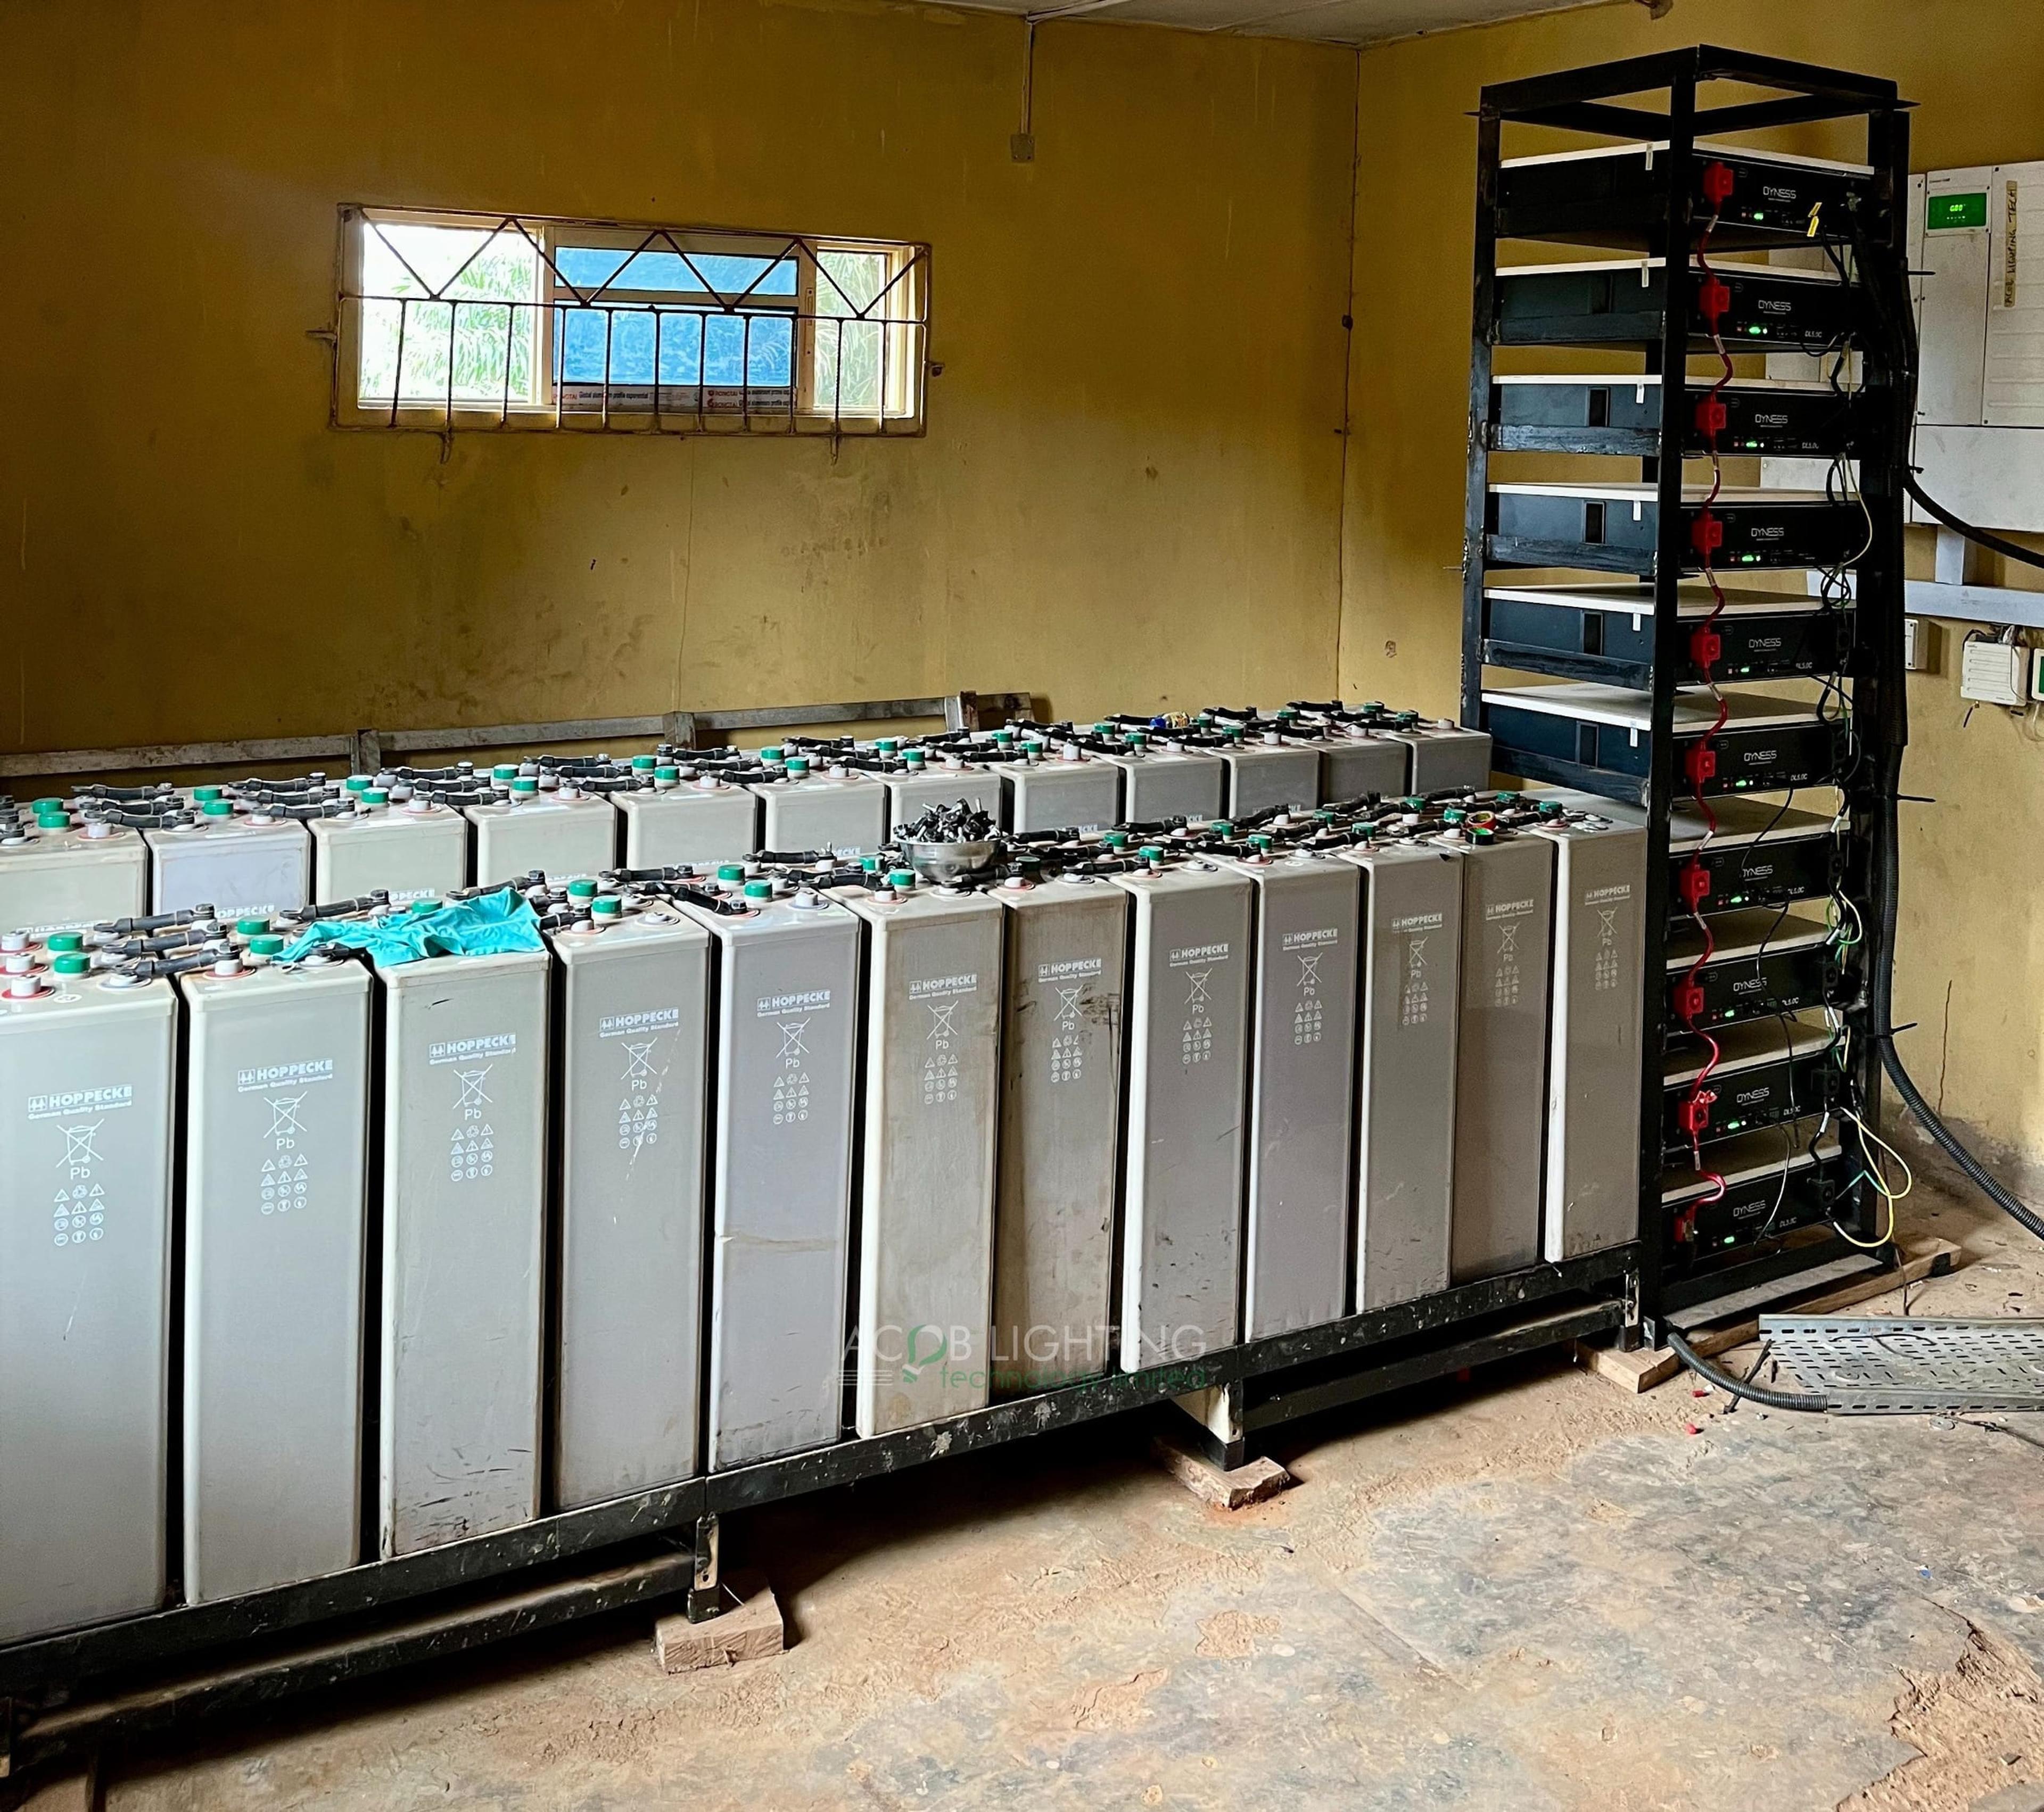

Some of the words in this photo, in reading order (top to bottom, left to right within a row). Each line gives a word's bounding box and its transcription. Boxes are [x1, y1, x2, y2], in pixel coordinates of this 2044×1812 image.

[1763, 186, 1796, 199] DYNESS
[1758, 300, 1791, 311] DYNESS
[1755, 414, 1788, 424] DYNESS
[1751, 527, 1784, 537] DYNESS
[1749, 638, 1782, 648] DYNESS
[1744, 750, 1777, 762] DYNESS
[1293, 928, 1338, 942] HOPPECKE
[1181, 944, 1229, 958] HOPPECKE
[1051, 958, 1102, 974] HOPPECKE
[922, 974, 977, 990] HOPPECKE
[772, 990, 830, 1008] HOPPECKE
[1192, 1004, 1204, 1015] Pb
[615, 1008, 679, 1027] HOPPECKE
[1062, 1021, 1075, 1031] Pb
[447, 1034, 516, 1054] HOPPECKE
[936, 1039, 949, 1050] Pb
[257, 1059, 333, 1081] HOPPECKE
[786, 1057, 800, 1069] Pb
[631, 1079, 647, 1091] Pb
[49, 1086, 133, 1107] HOPPECKE
[1736, 1087, 1770, 1104] DYNESS
[28, 1111, 62, 1120] German
[63, 1105, 93, 1116] Quality
[465, 1108, 482, 1120] Pb
[276, 1137, 295, 1151] Pb
[70, 1166, 91, 1180] Pb
[1733, 1199, 1767, 1217] DYNESS
